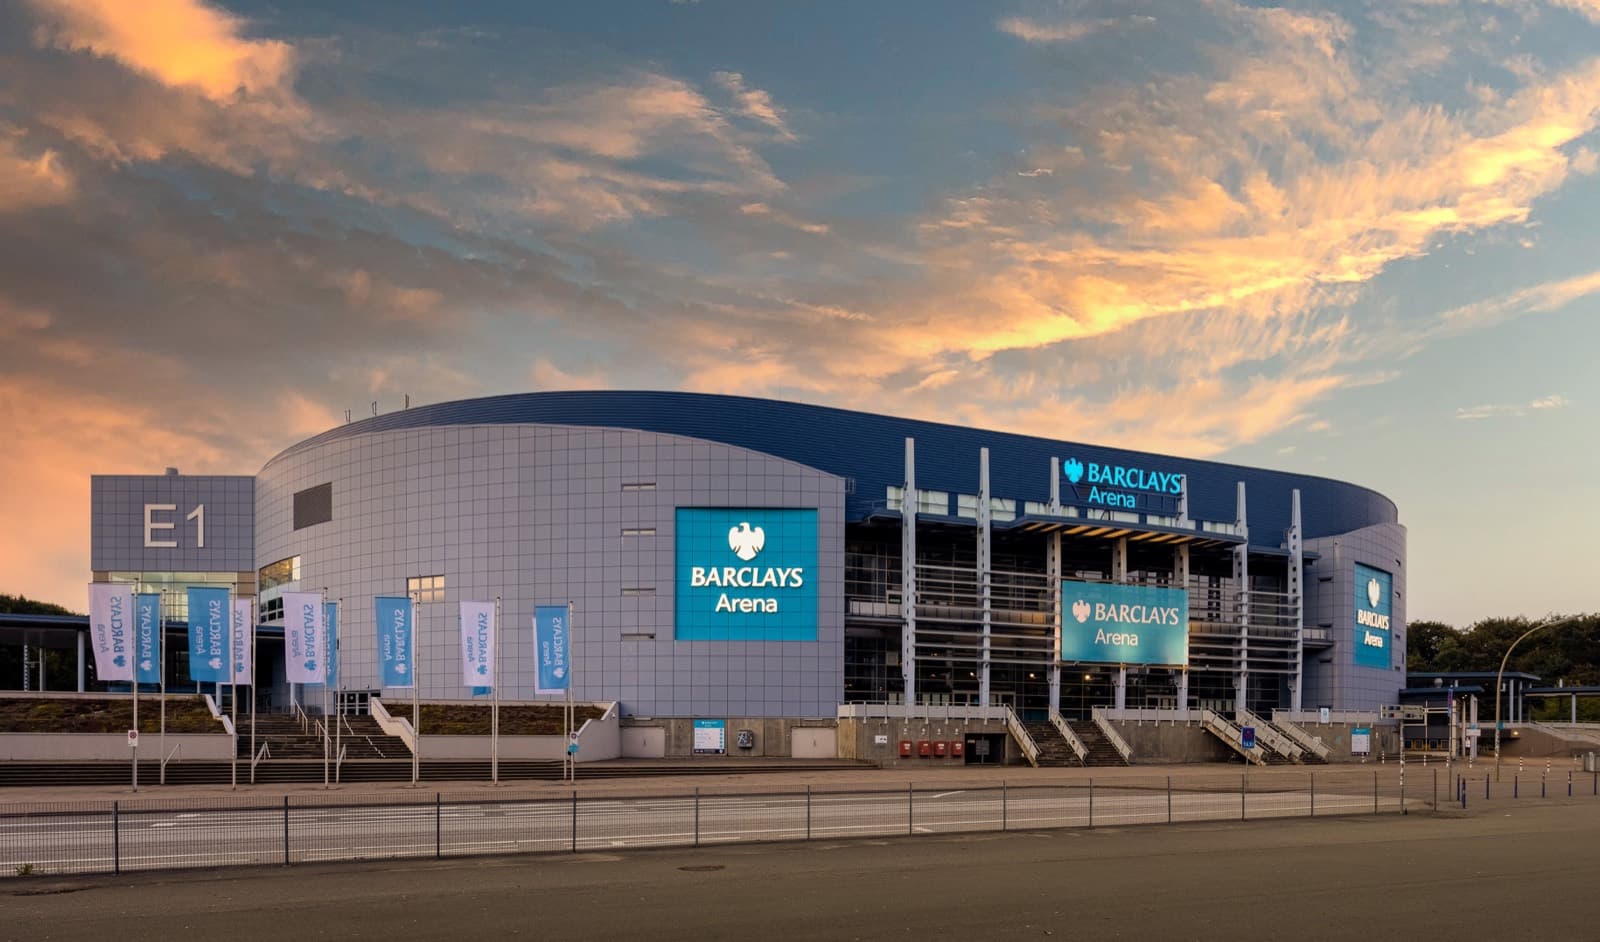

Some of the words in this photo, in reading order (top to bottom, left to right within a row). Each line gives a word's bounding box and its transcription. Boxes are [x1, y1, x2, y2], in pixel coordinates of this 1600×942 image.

[1087, 463, 1181, 494] BARCLAYS
[1088, 486, 1136, 508] Arena
[144, 504, 205, 548] E1
[691, 567, 803, 587] BARCLAYS
[715, 593, 778, 612] Arena
[1095, 603, 1179, 625] BARCLAYS
[1357, 609, 1389, 630] BARCLAYS
[1095, 628, 1138, 646] Arena
[1364, 631, 1383, 648] Arena
